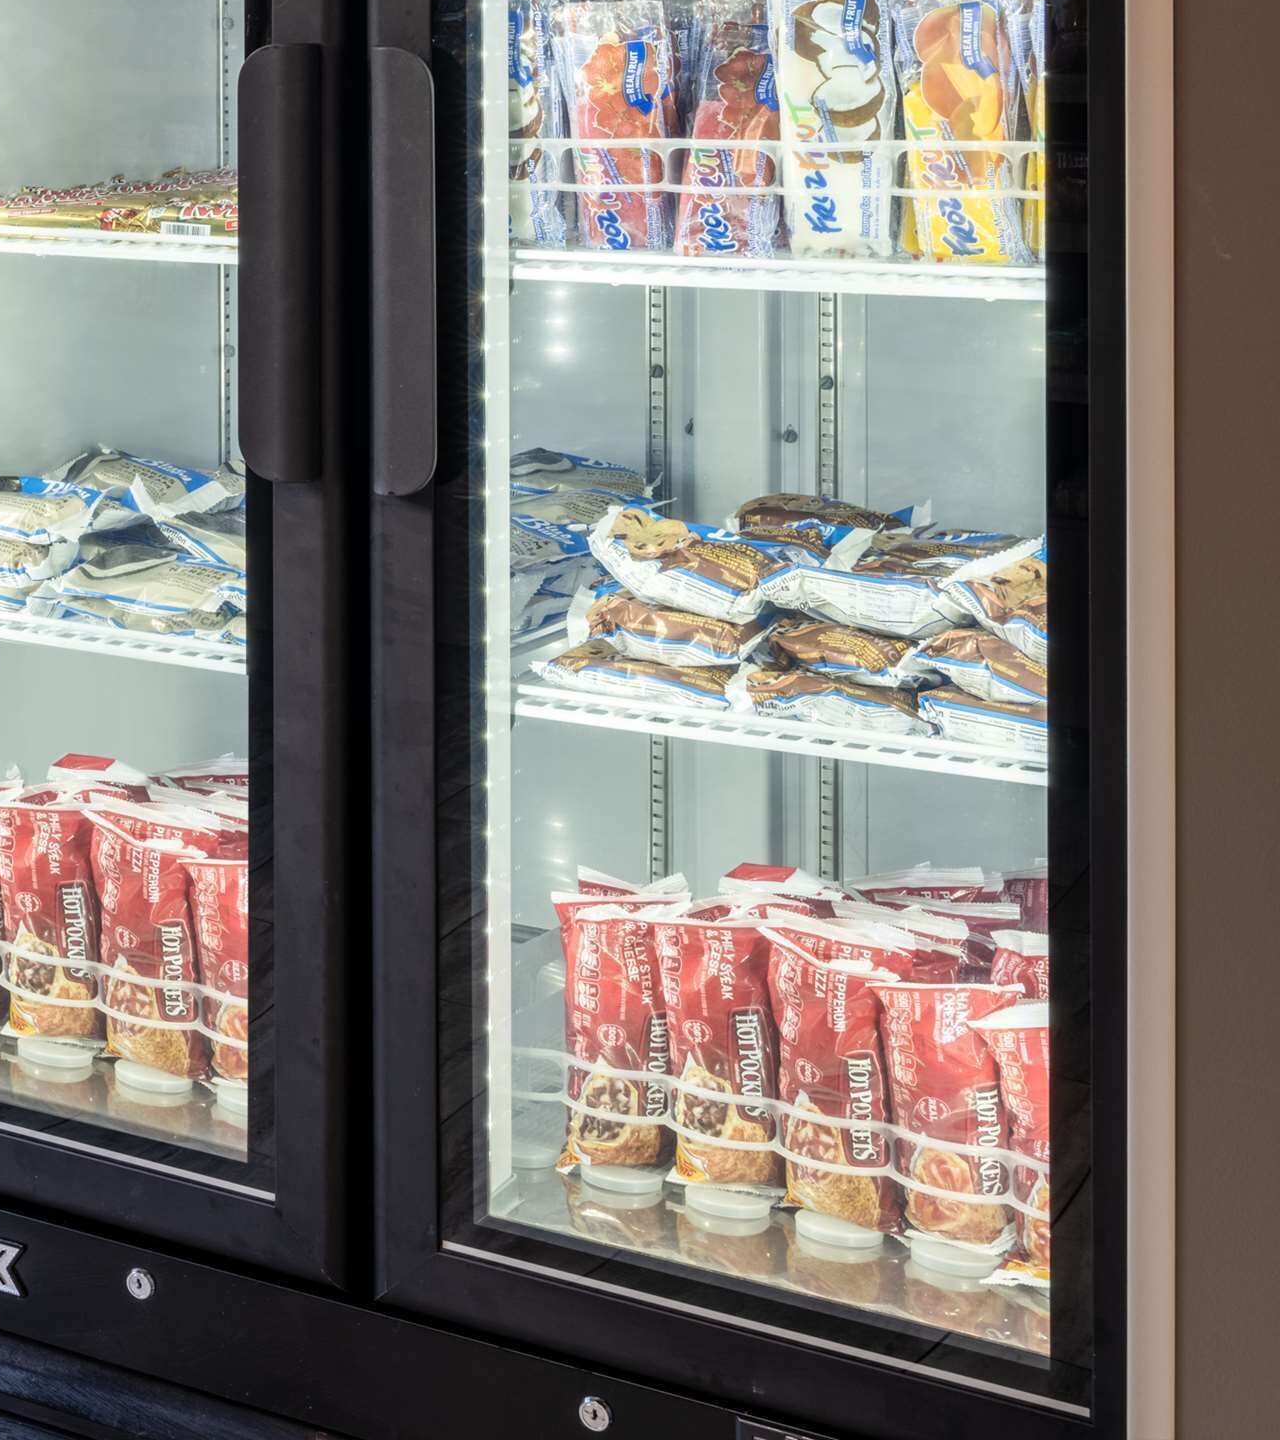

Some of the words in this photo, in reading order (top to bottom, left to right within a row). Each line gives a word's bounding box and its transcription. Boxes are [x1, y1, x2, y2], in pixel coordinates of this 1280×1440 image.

[962, 8, 972, 33] FRUIT
[962, 34, 972, 58] REAL
[629, 51, 638, 74] FRUIT
[627, 74, 635, 96] REAL
[62, 887, 83, 916] HOT
[161, 925, 183, 956] HOT
[640, 963, 653, 1005] STEAK
[735, 1015, 758, 1047] HOT
[847, 1059, 871, 1090] HOT
[976, 1090, 999, 1125] HOT
